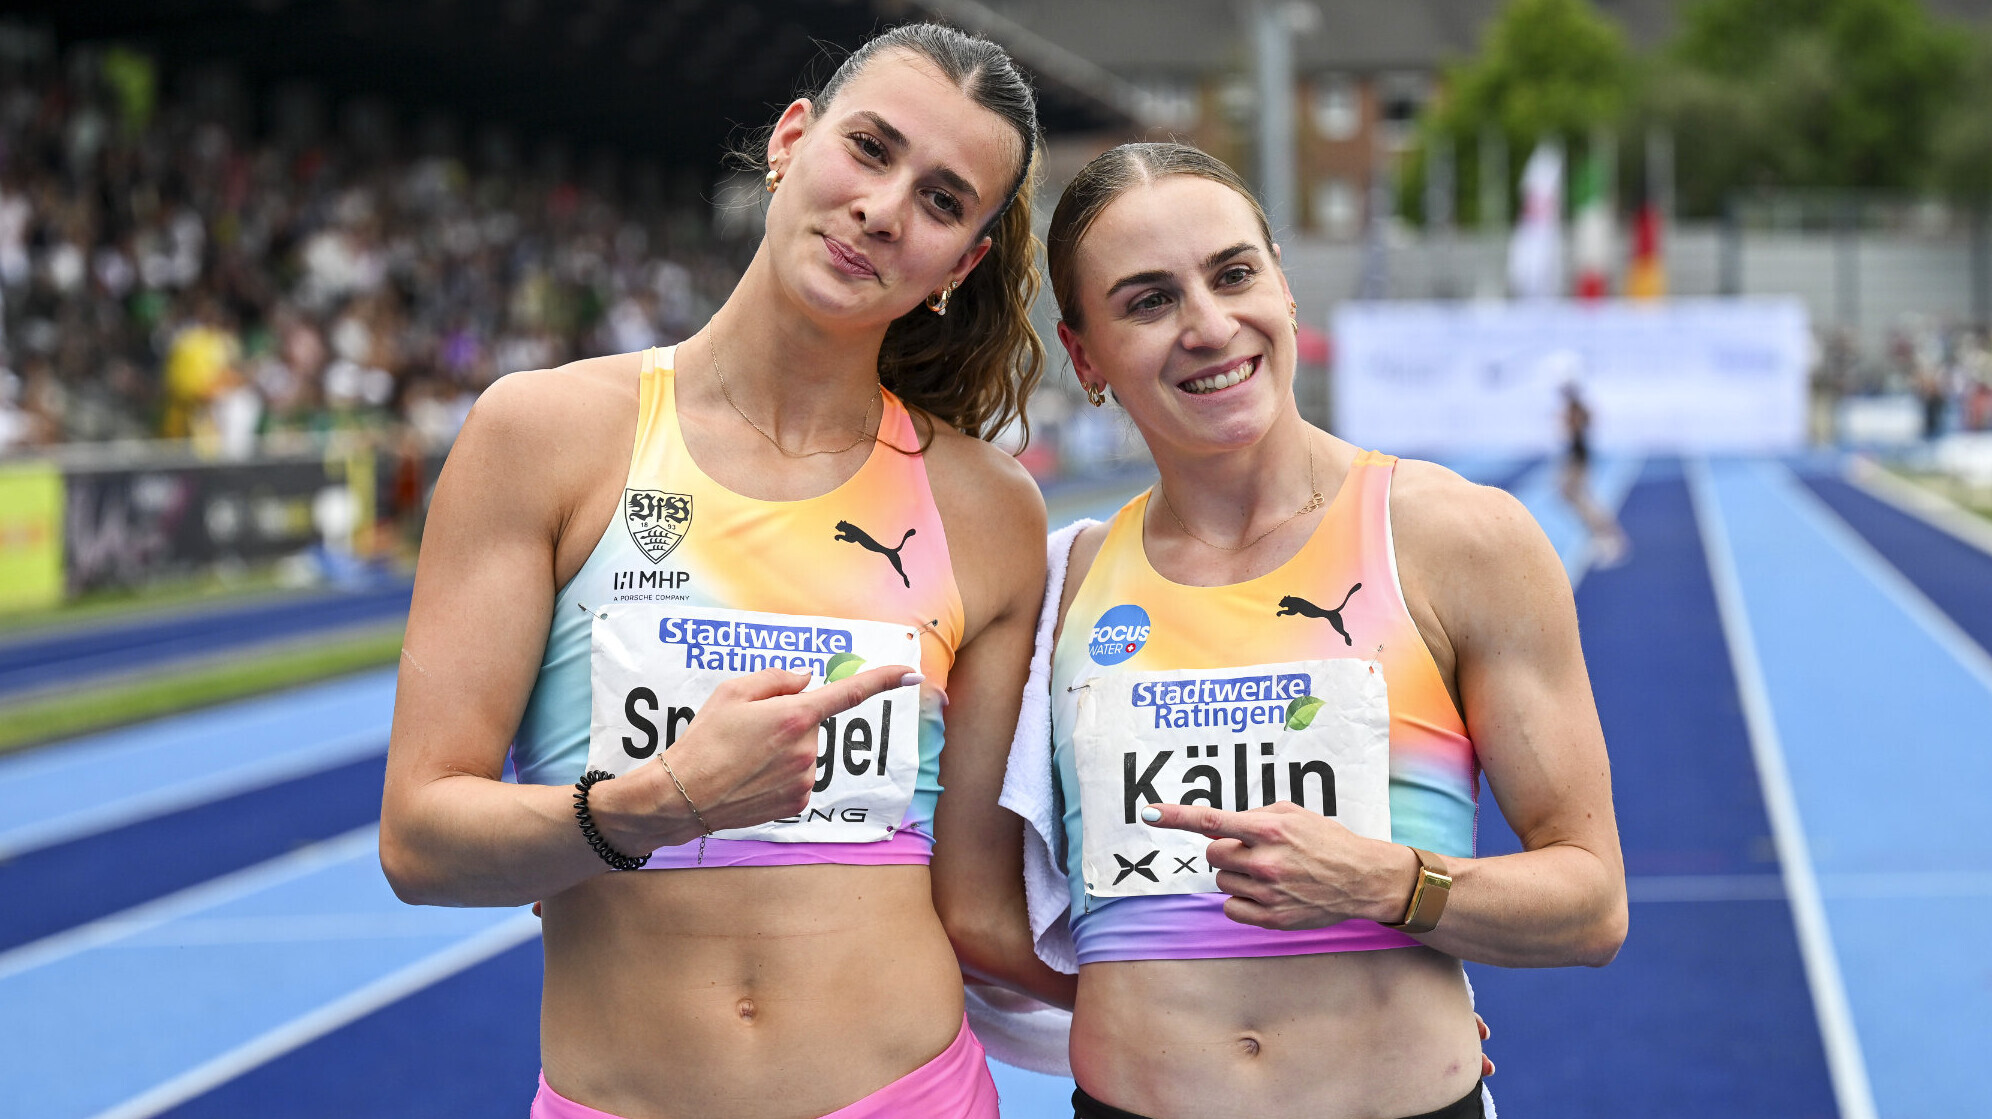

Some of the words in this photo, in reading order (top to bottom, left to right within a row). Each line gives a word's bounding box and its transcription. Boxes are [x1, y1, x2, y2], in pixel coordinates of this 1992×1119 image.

[639, 571, 690, 589] MHP
[665, 617, 847, 654] Stadtwerke
[1088, 625, 1150, 644] FOCUS
[1089, 643, 1124, 656] WATER
[1136, 676, 1306, 707] Stadtwerke
[1154, 703, 1285, 733] Ratingen
[1123, 742, 1337, 825] Kälin
